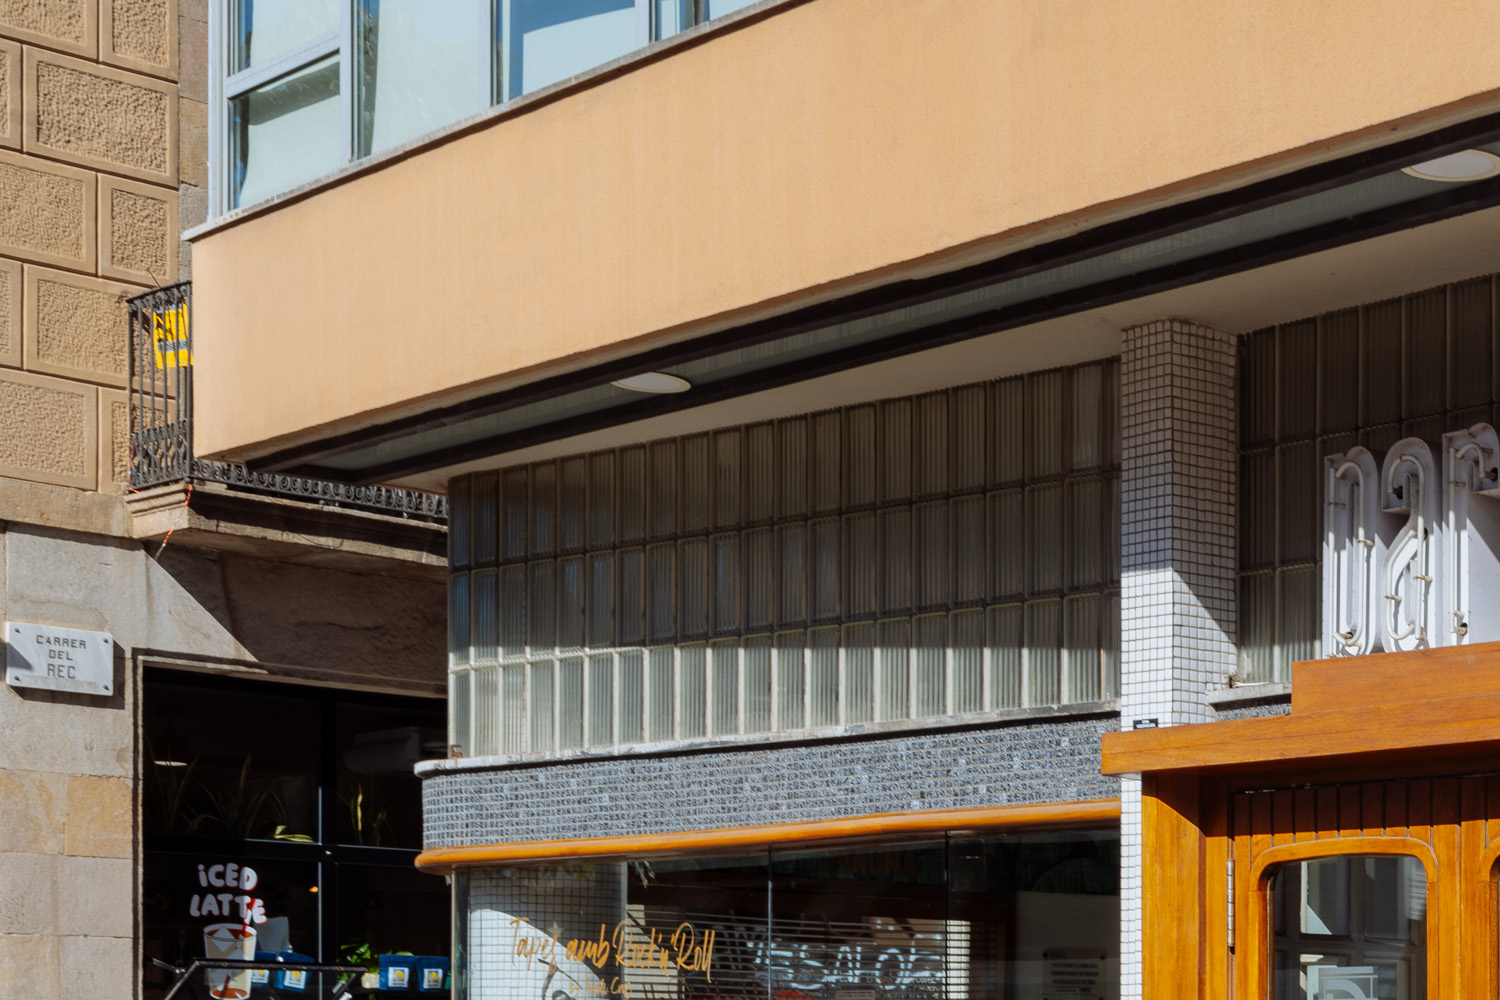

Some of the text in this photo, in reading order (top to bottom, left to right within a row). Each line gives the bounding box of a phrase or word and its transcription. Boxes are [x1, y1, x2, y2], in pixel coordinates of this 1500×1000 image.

[36, 634, 87, 650] CARRER
[48, 649, 74, 661] DEL
[47, 663, 76, 679] REC
[189, 893, 268, 925] LATTE
[565, 923, 610, 969] amb
